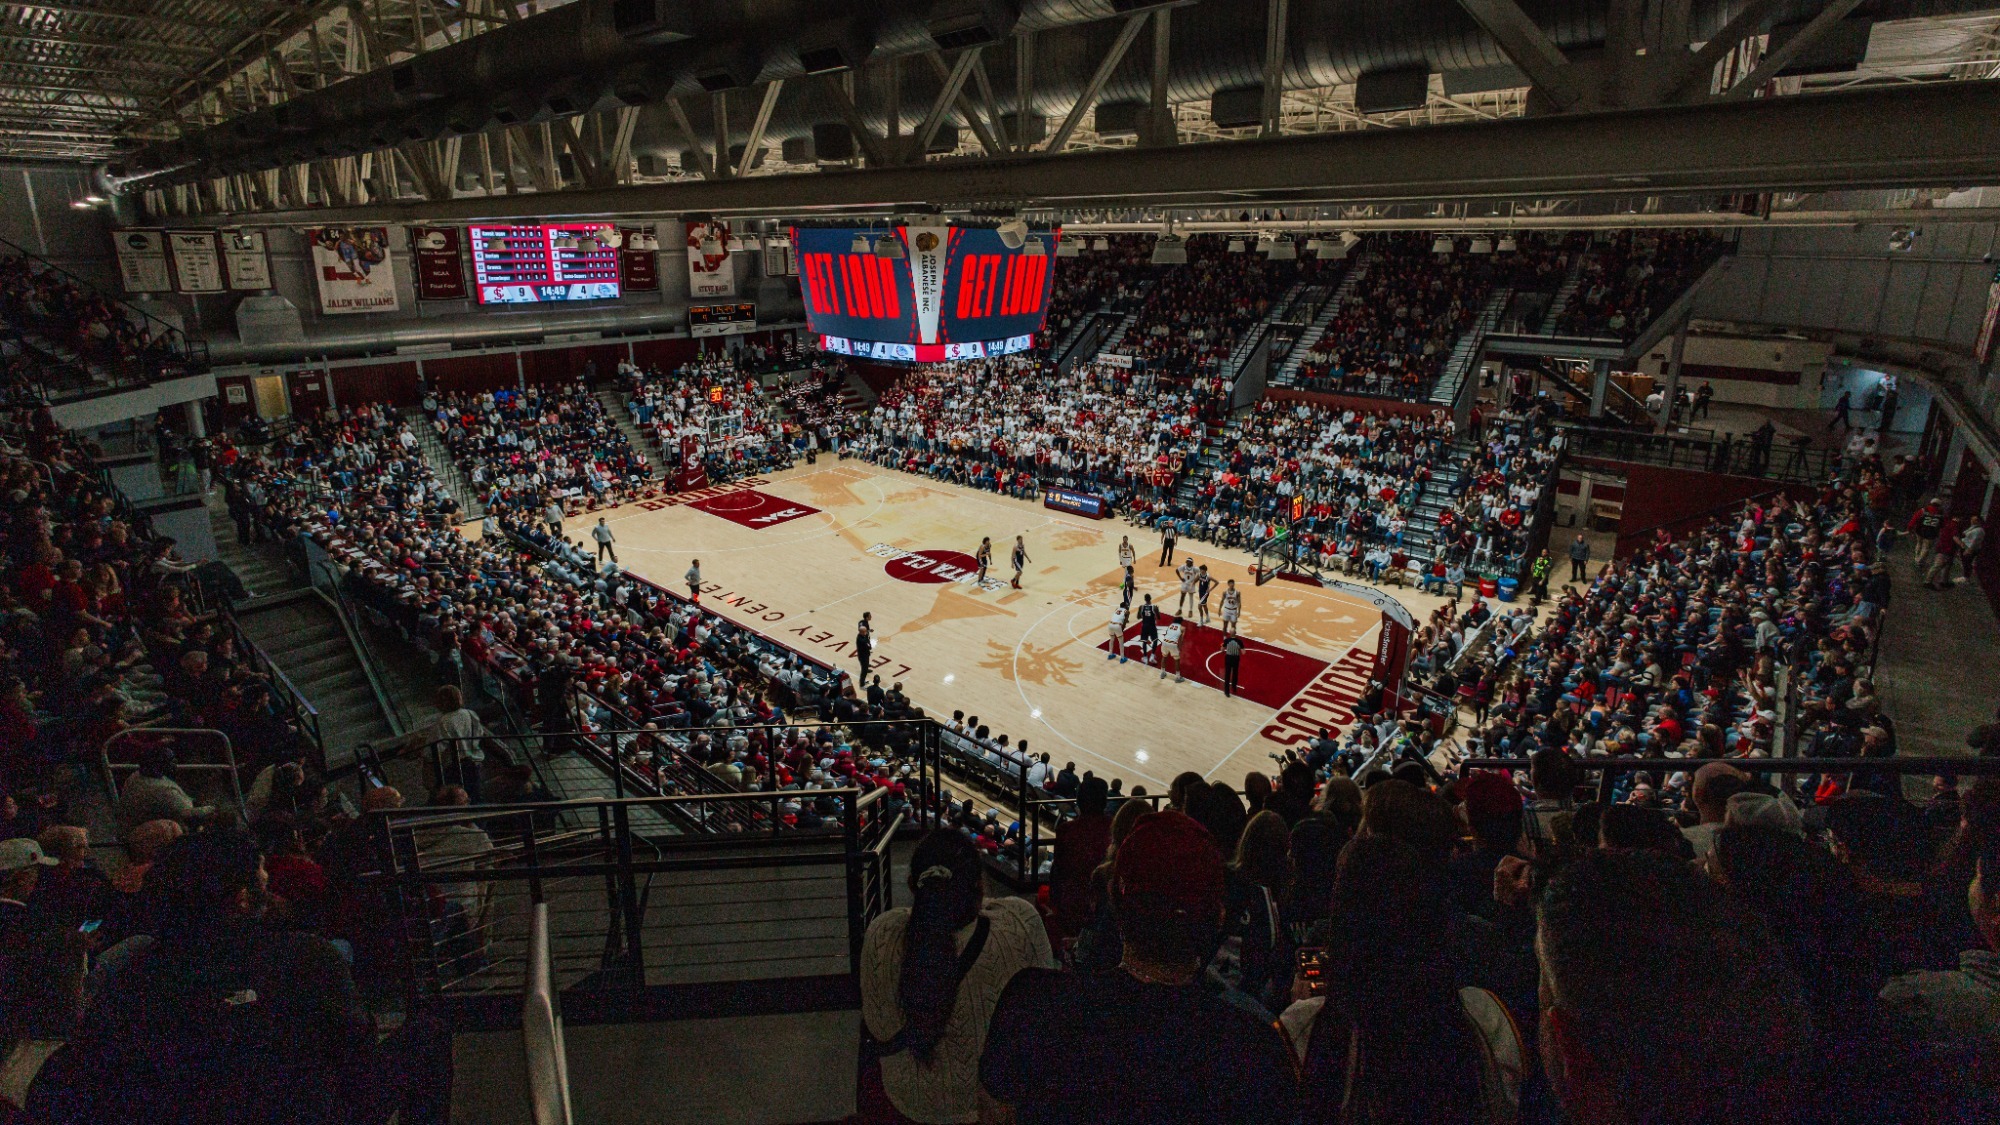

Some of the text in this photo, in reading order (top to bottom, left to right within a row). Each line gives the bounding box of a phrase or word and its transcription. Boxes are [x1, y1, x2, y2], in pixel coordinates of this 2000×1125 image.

[929, 254, 937, 286] JOSEPH
[580, 285, 587, 294] 4
[804, 253, 840, 315] GET
[838, 253, 900, 319] LOUD
[921, 254, 930, 314] ALBANESE INC.
[956, 254, 1048, 319] GET LOUD
[518, 287, 525, 297] 9
[540, 286, 566, 296] 14:49
[326, 297, 395, 308] JALEN WILLIAMS
[853, 341, 870, 353] 14:49
[880, 344, 886, 354] 4
[972, 343, 978, 354] 9
[987, 340, 1004, 352] 14:49
[635, 477, 771, 511] BRONCOS
[865, 542, 938, 569] CLARA
[699, 580, 786, 621] CENTE
